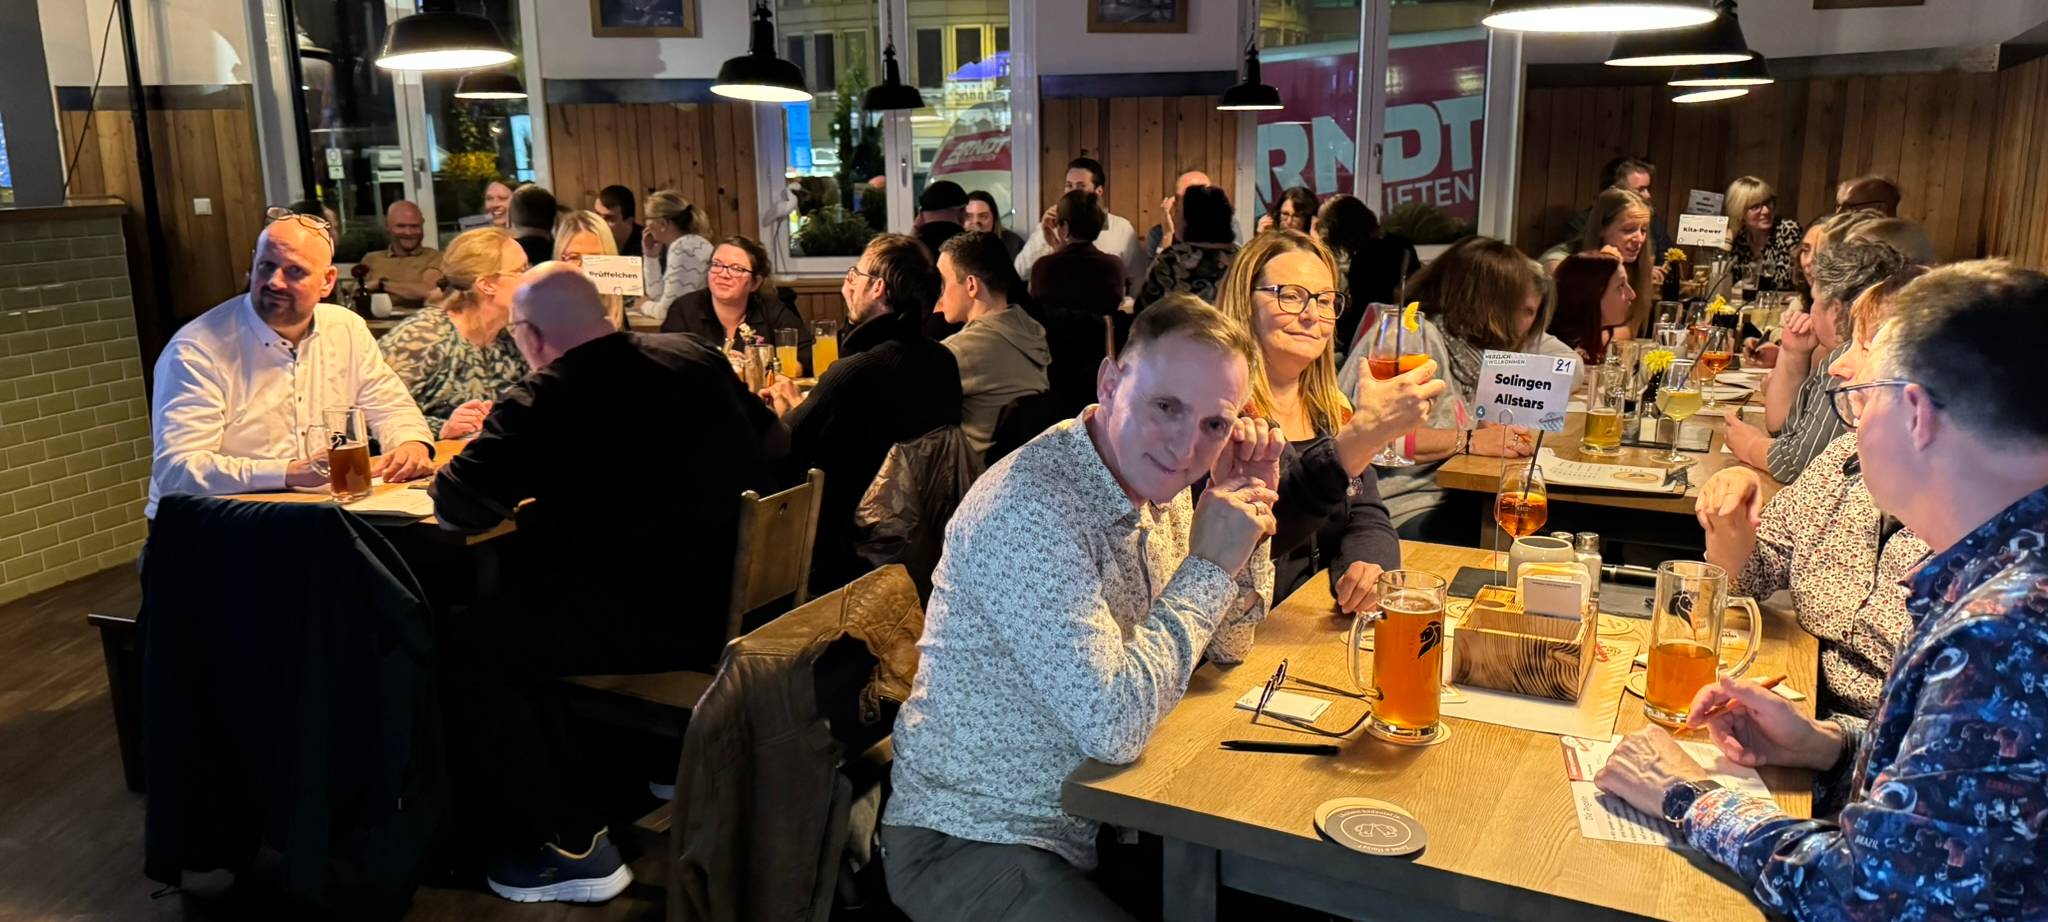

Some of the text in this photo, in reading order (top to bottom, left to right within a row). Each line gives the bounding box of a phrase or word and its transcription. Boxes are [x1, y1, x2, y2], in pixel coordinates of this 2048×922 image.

[1256, 95, 1483, 216] RNDT
[1683, 226, 1721, 234] Kita-Power
[1555, 358, 1571, 373] 21
[1494, 373, 1552, 391] Solingen
[1494, 393, 1545, 410] Allstars
